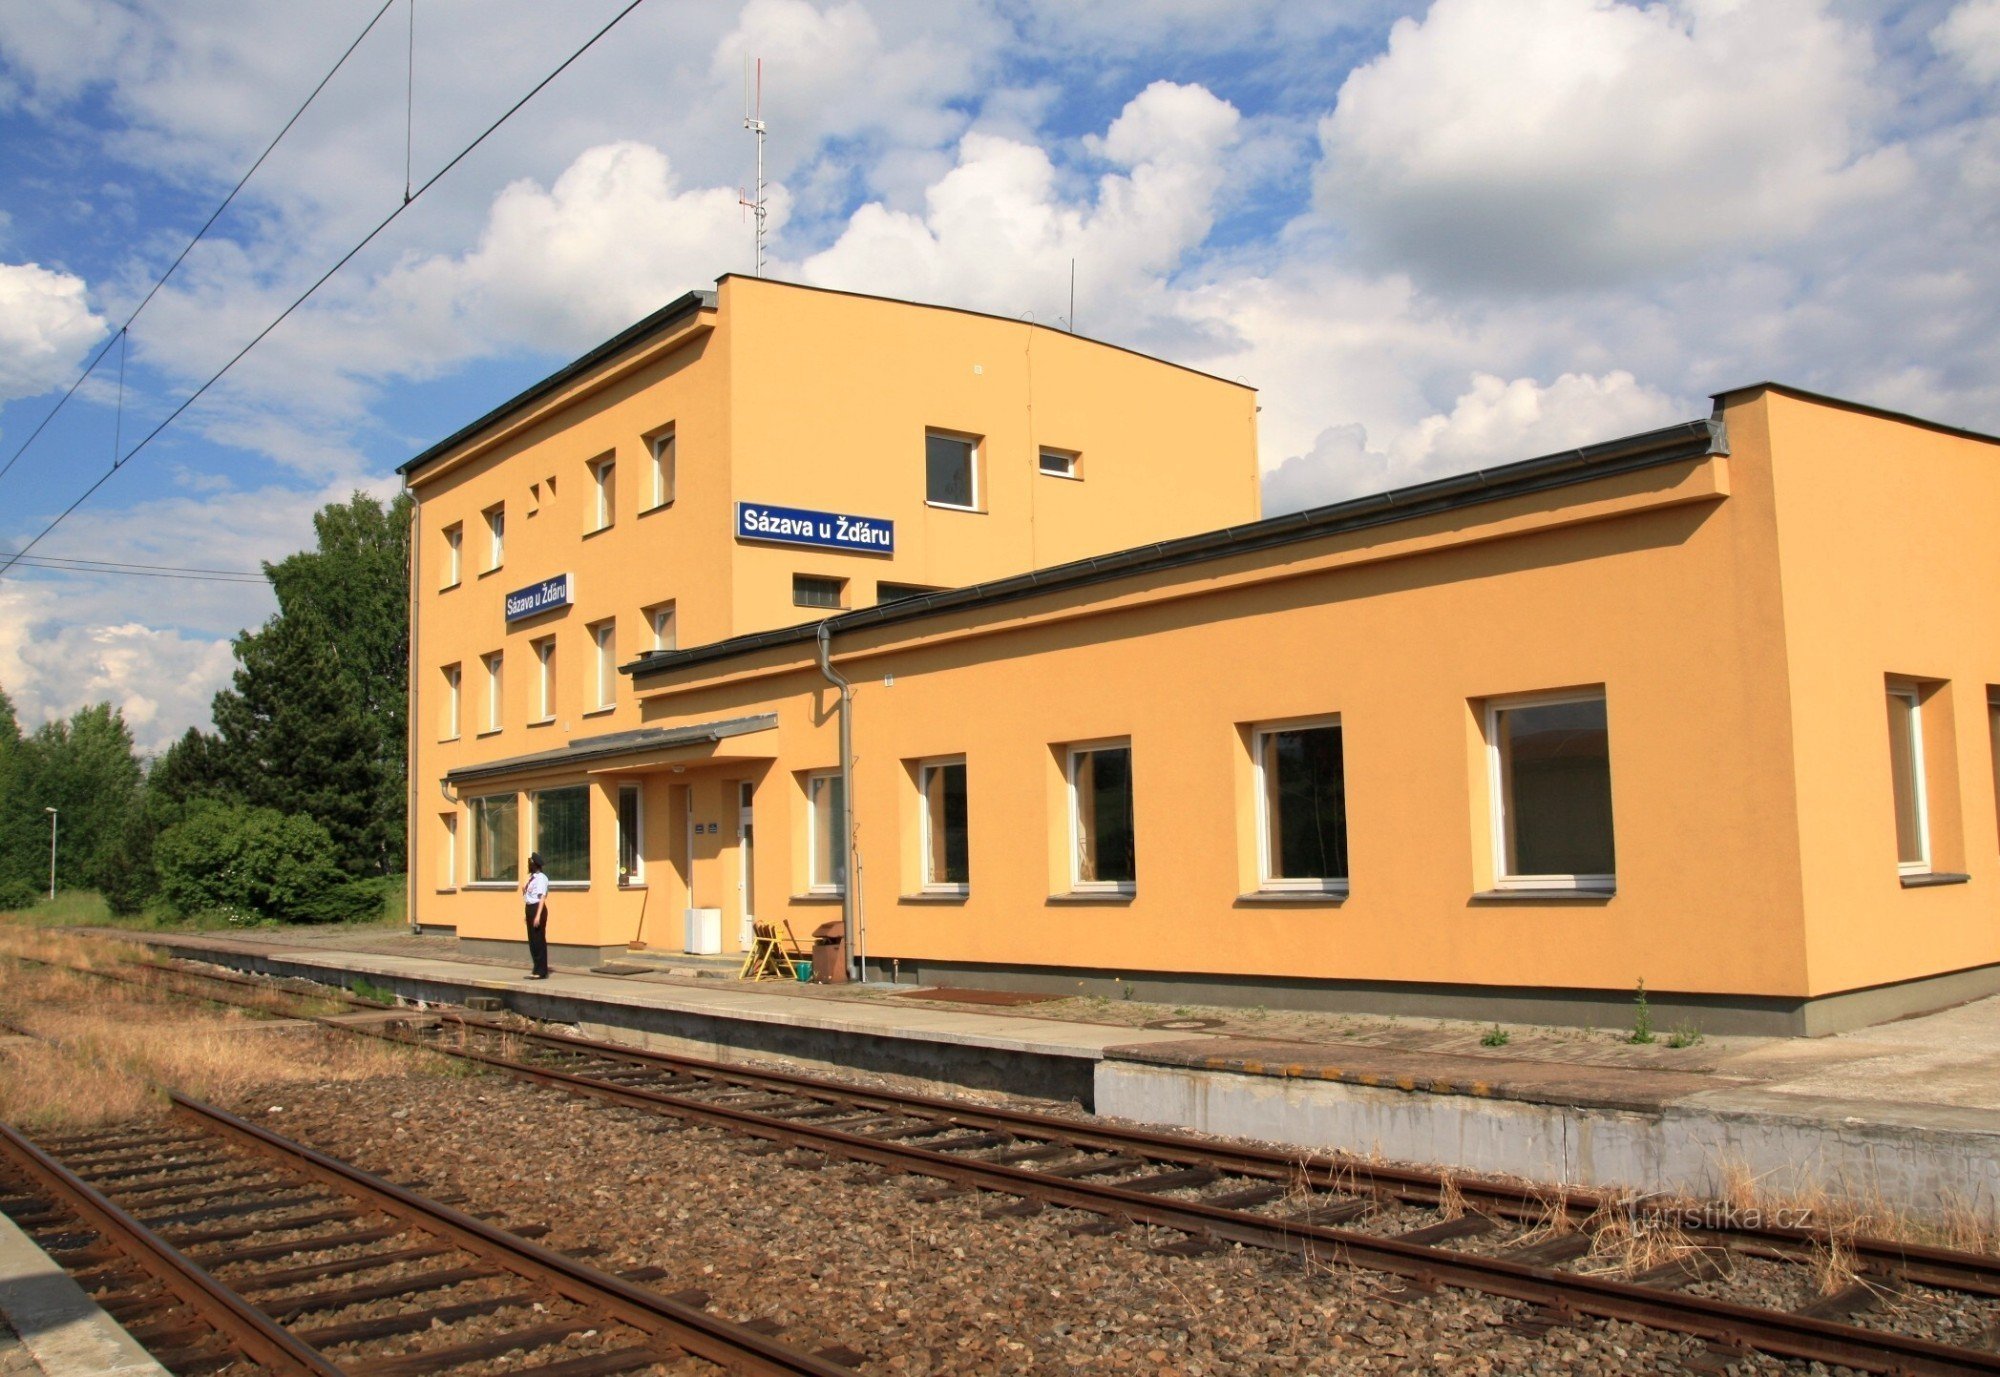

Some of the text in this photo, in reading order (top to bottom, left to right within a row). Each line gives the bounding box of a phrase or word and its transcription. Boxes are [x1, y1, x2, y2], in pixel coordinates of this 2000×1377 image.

[744, 509, 890, 545] Sázava u Žďáru
[507, 583, 566, 615] Sázava u Žďáru
